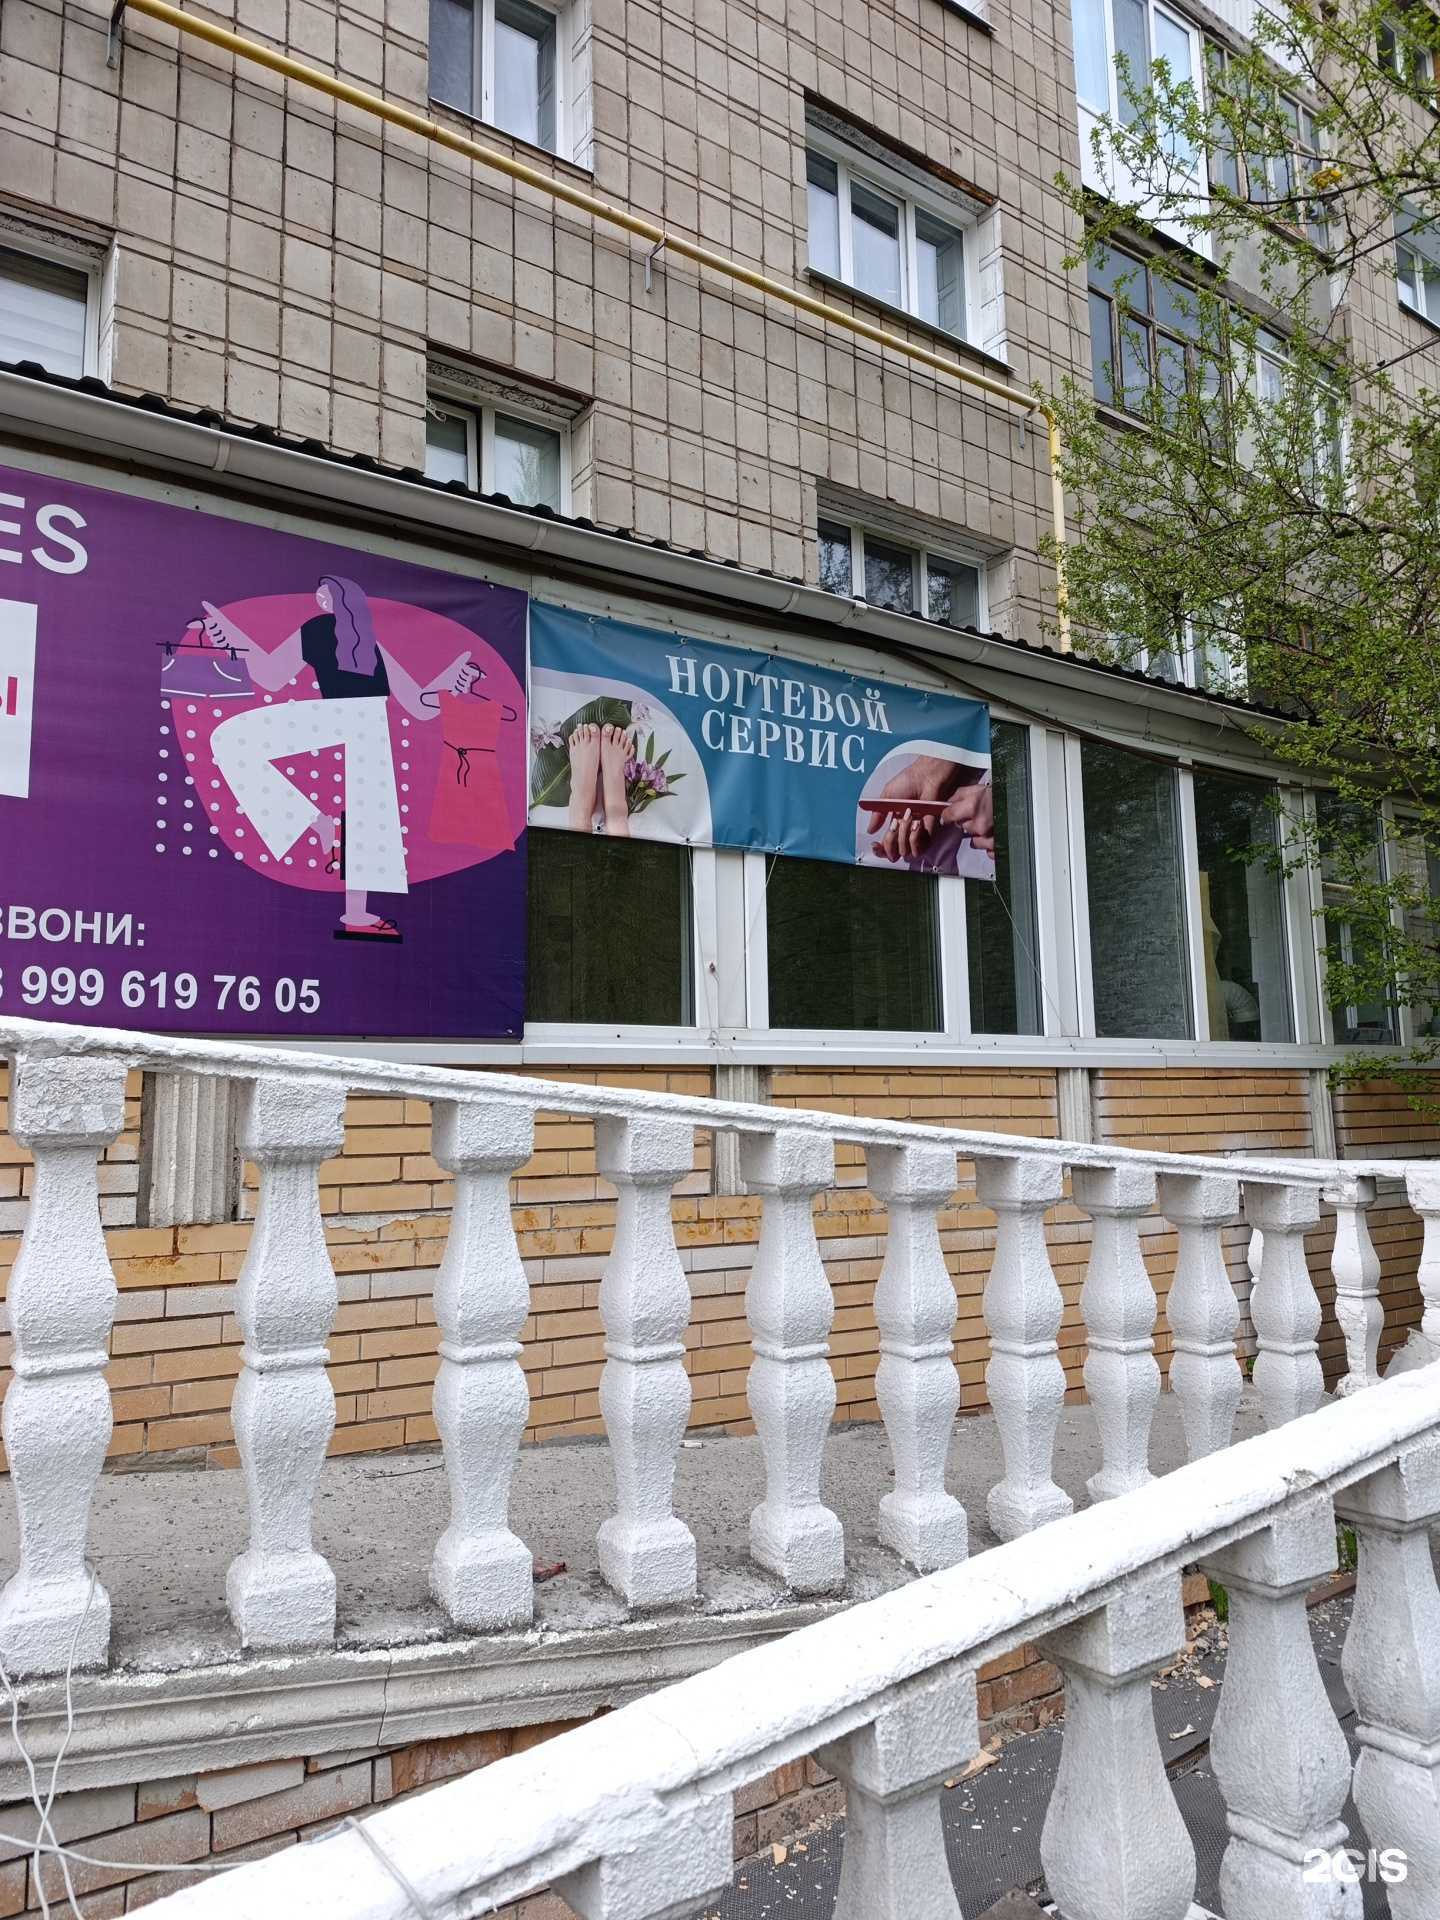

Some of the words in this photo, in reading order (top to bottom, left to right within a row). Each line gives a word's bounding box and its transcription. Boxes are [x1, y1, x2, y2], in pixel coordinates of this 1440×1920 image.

[665, 655, 893, 734] НОГТЕВОЙ
[701, 709, 865, 773] СЕРВИС
[0, 905, 145, 947] ВОНИ:
[21, 965, 104, 1007] 999
[121, 970, 198, 1010] 619
[213, 974, 261, 1012] 76
[275, 977, 321, 1014] 05
